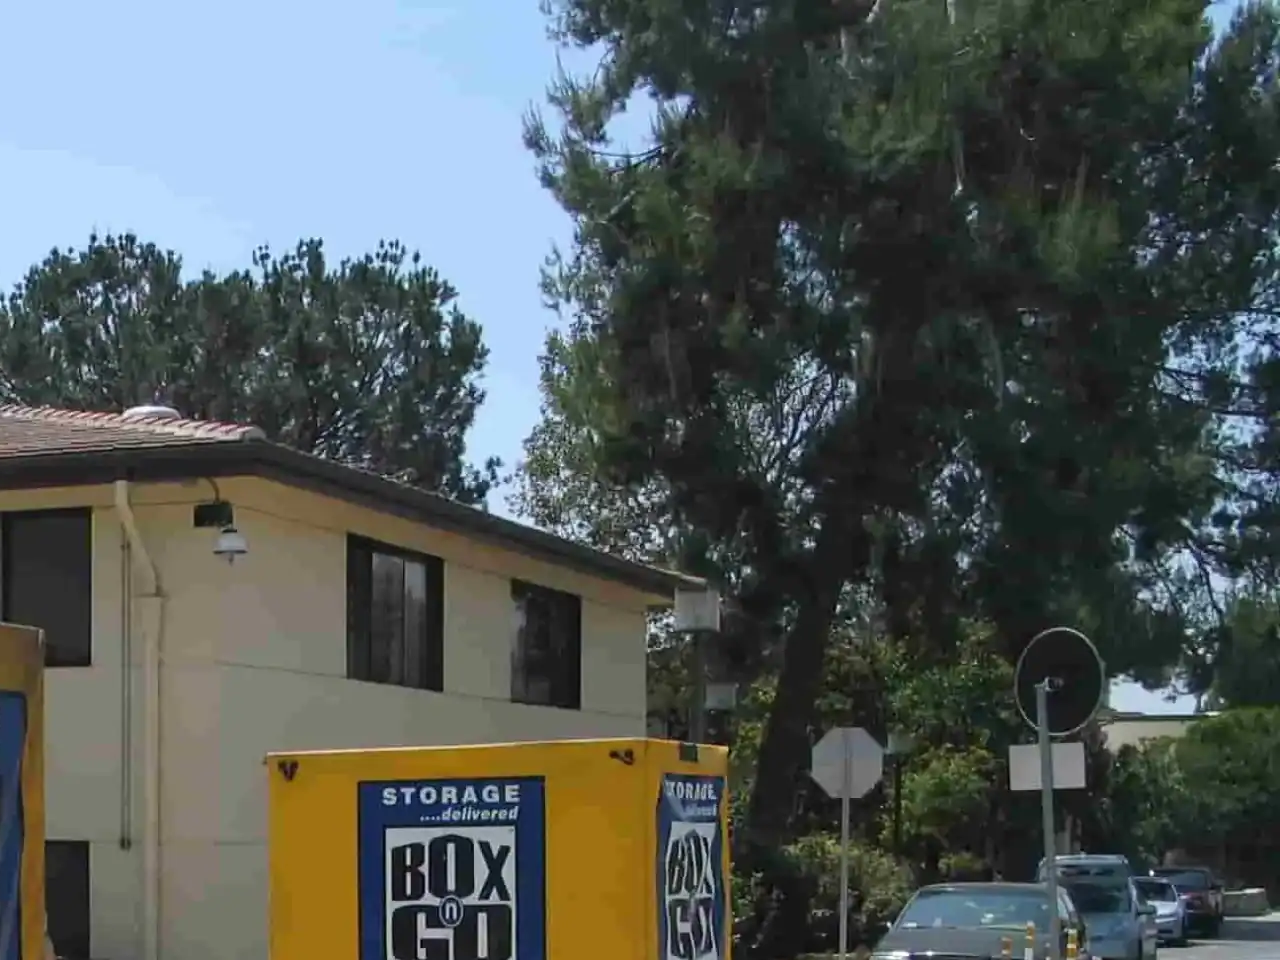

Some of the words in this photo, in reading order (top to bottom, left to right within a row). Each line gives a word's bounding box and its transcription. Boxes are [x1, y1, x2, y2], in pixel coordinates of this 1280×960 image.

[382, 784, 520, 805] STORAGE
[391, 834, 511, 901] BOX
[668, 830, 714, 896] BOX
